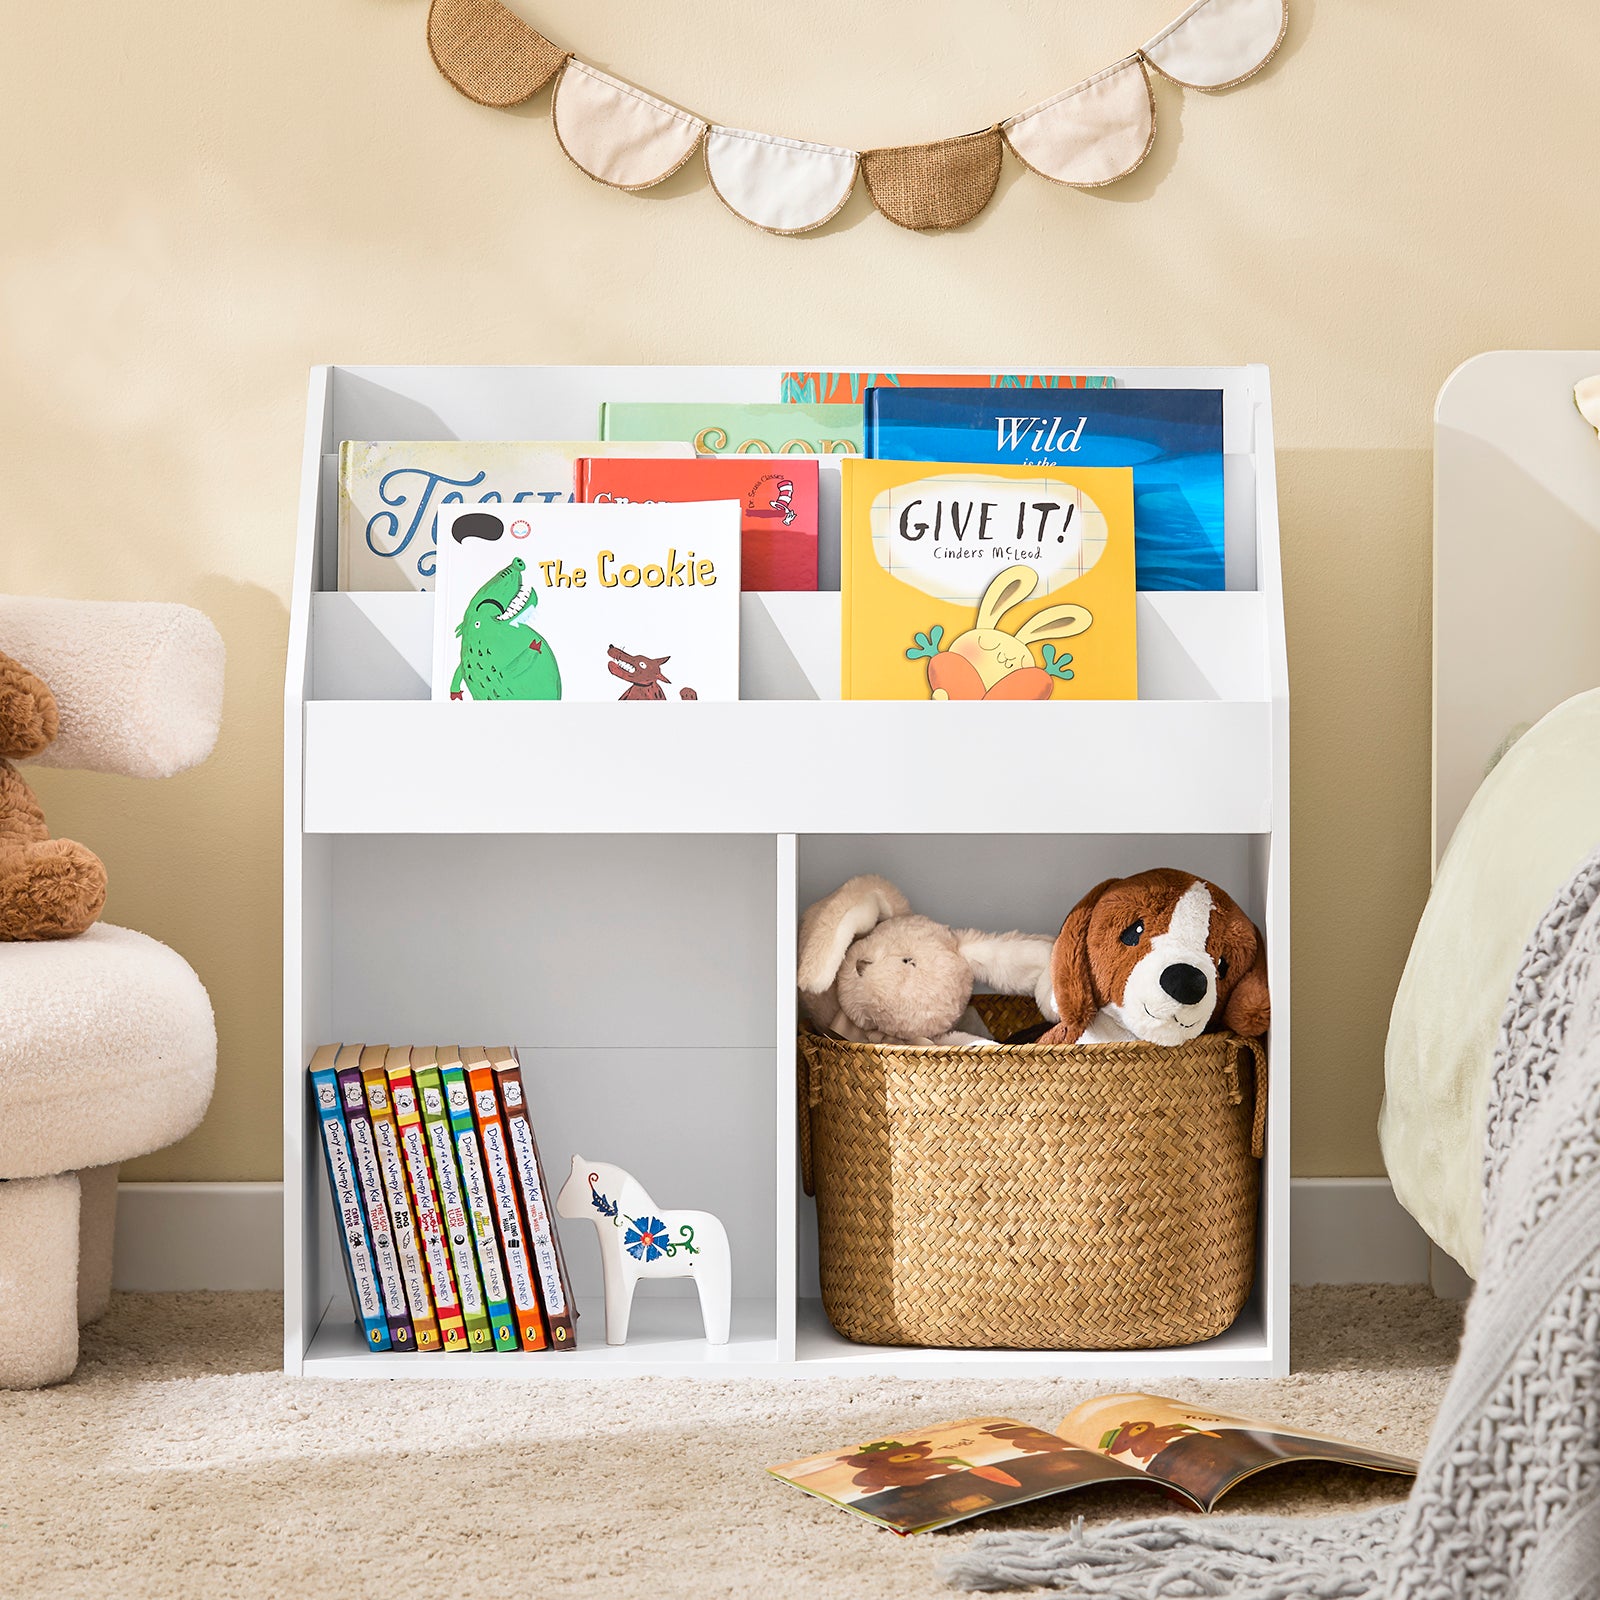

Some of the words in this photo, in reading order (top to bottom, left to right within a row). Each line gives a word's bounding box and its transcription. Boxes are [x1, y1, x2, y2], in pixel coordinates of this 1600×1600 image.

[995, 416, 1088, 452] Wild
[899, 500, 998, 541] GIVE
[1016, 501, 1075, 543] IT!
[933, 546, 984, 559] Cinders
[992, 546, 1043, 561] McLeod
[538, 559, 587, 588] The
[596, 547, 717, 588] Cookie
[328, 1121, 341, 1146] Diary
[355, 1120, 368, 1145] Diary
[433, 1126, 445, 1150] Diary
[462, 1136, 473, 1158] Diary
[379, 1122, 392, 1148] Diary
[388, 1163, 398, 1190] Wimpy
[393, 1191, 403, 1205] Kid
[407, 1133, 419, 1156] Diary
[416, 1170, 426, 1195] Wimpy
[421, 1195, 430, 1208] Kid
[487, 1128, 500, 1152] Diary
[496, 1167, 506, 1194] Wimpy
[501, 1195, 511, 1209] Kid
[514, 1120, 526, 1144] Diary
[523, 1160, 534, 1187] Wimpy
[529, 1188, 539, 1202] Kid
[338, 1162, 349, 1189] Wimpy
[365, 1160, 375, 1188] Wimpy
[442, 1164, 452, 1190] Wimpy
[471, 1171, 480, 1195] Wimpy
[343, 1190, 353, 1204] Kid
[369, 1189, 380, 1202] Kid
[446, 1191, 456, 1204] Kid
[475, 1196, 484, 1208] Kid
[344, 1209, 353, 1229] FEVER
[351, 1207, 360, 1226] CABIN
[370, 1209, 380, 1231] TRUTH
[376, 1203, 384, 1218] THE
[394, 1212, 403, 1229] DAYS
[401, 1211, 410, 1228] DOG
[447, 1209, 457, 1228] LUCK
[454, 1207, 464, 1227] HARD
[507, 1209, 515, 1221] THE
[379, 1218, 388, 1232] UGLY
[502, 1218, 510, 1233] HAUL
[510, 1222, 519, 1237] LONG
[356, 1252, 367, 1273] JEFF
[382, 1251, 393, 1272] JEFF
[406, 1254, 417, 1275] JEFF
[432, 1249, 443, 1267] JEFF
[459, 1251, 469, 1270] JEFF
[486, 1247, 495, 1265] JEFF
[511, 1250, 523, 1270] JEFF
[541, 1250, 553, 1271] JEFF
[387, 1275, 400, 1311] KINNEY
[437, 1271, 449, 1302] KINNEY
[463, 1274, 475, 1307] KINNEY
[489, 1267, 501, 1298] KINNEY
[516, 1273, 529, 1307] KINNEY
[546, 1275, 559, 1310] KINNEY
[361, 1276, 374, 1312] KINNEY
[410, 1278, 424, 1314] KINNEY
